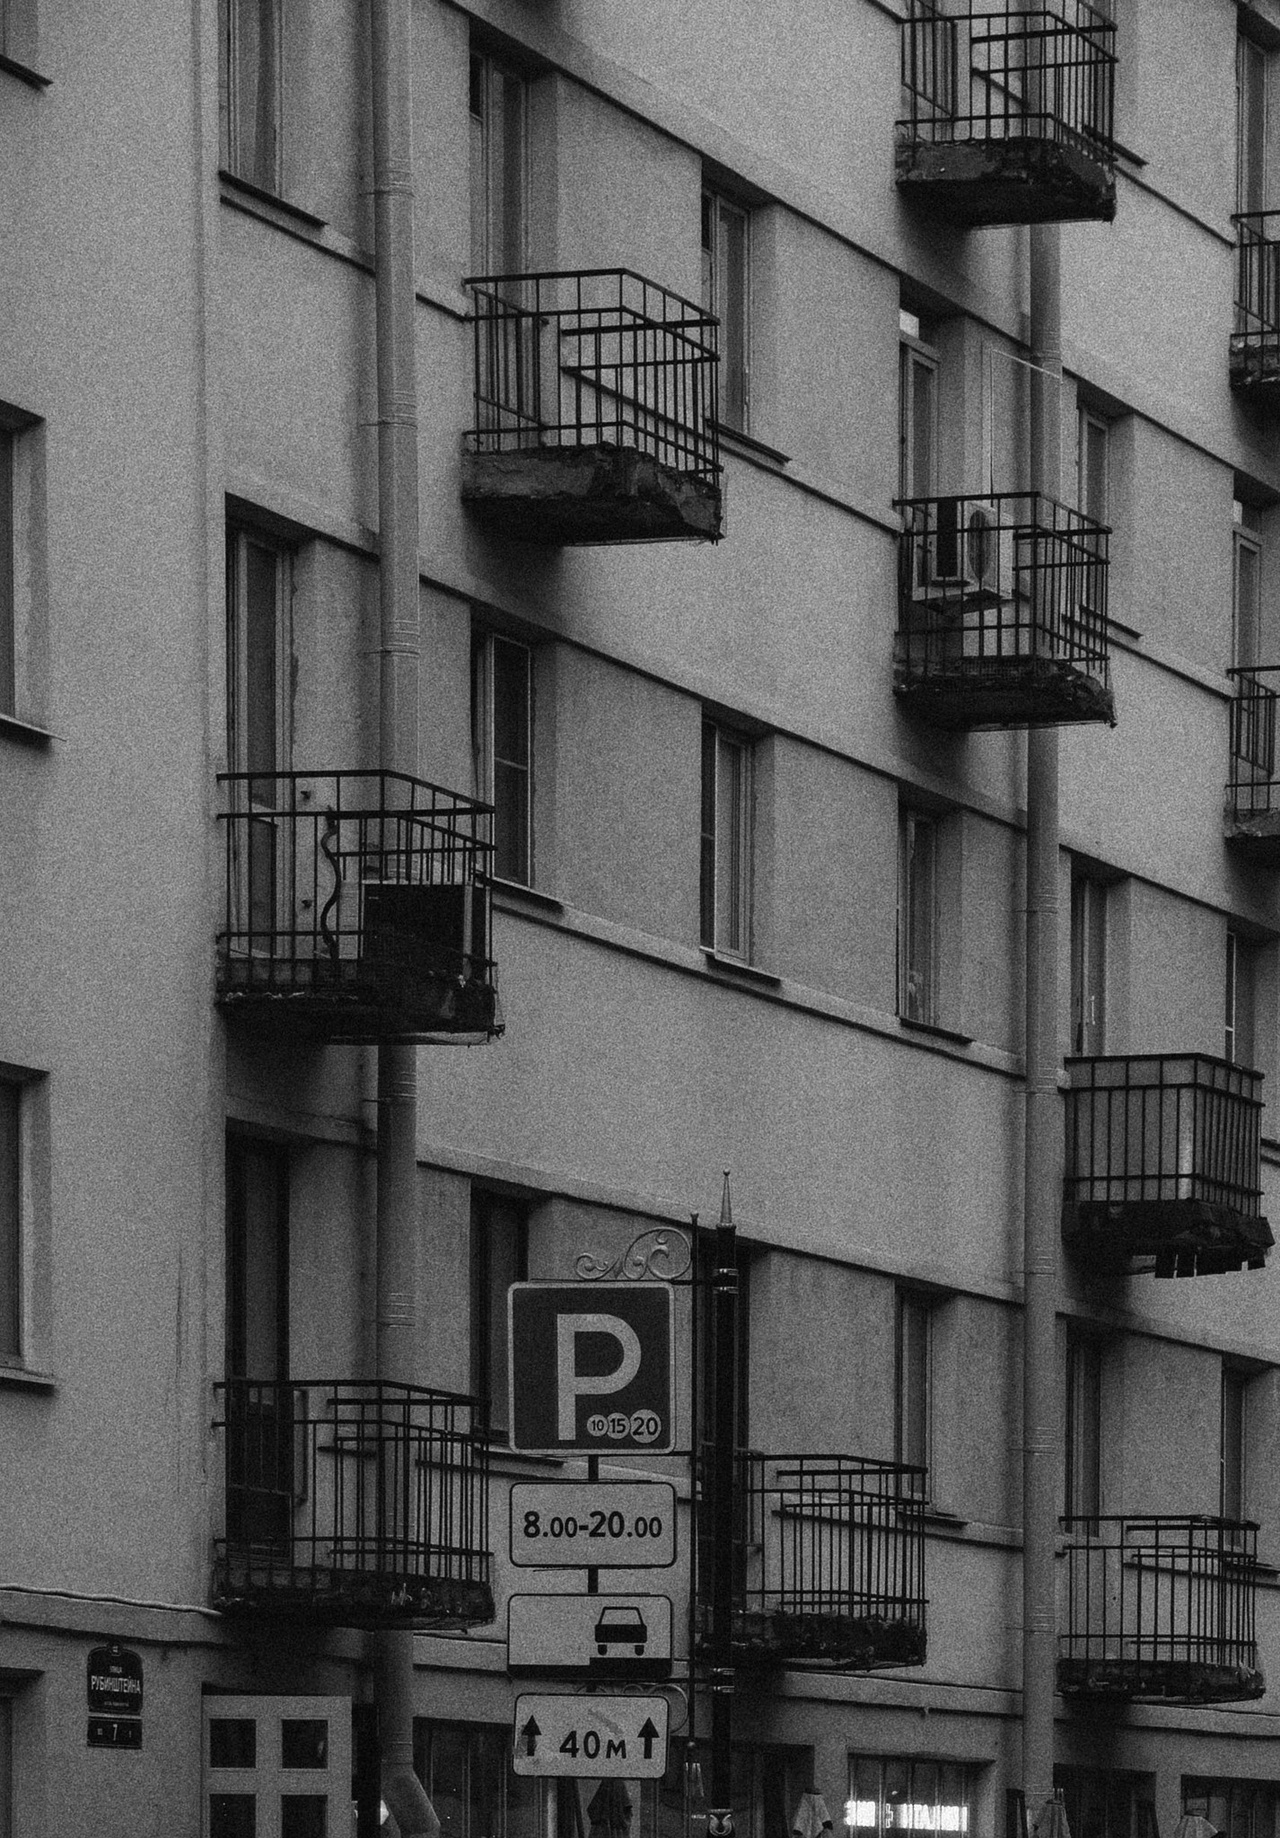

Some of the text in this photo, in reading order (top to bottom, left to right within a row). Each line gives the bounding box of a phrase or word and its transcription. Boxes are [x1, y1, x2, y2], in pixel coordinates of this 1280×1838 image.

[557, 1314, 641, 1440] P
[591, 1417, 658, 1435] 10 15 20
[524, 1511, 662, 1538] 8.00-20.00
